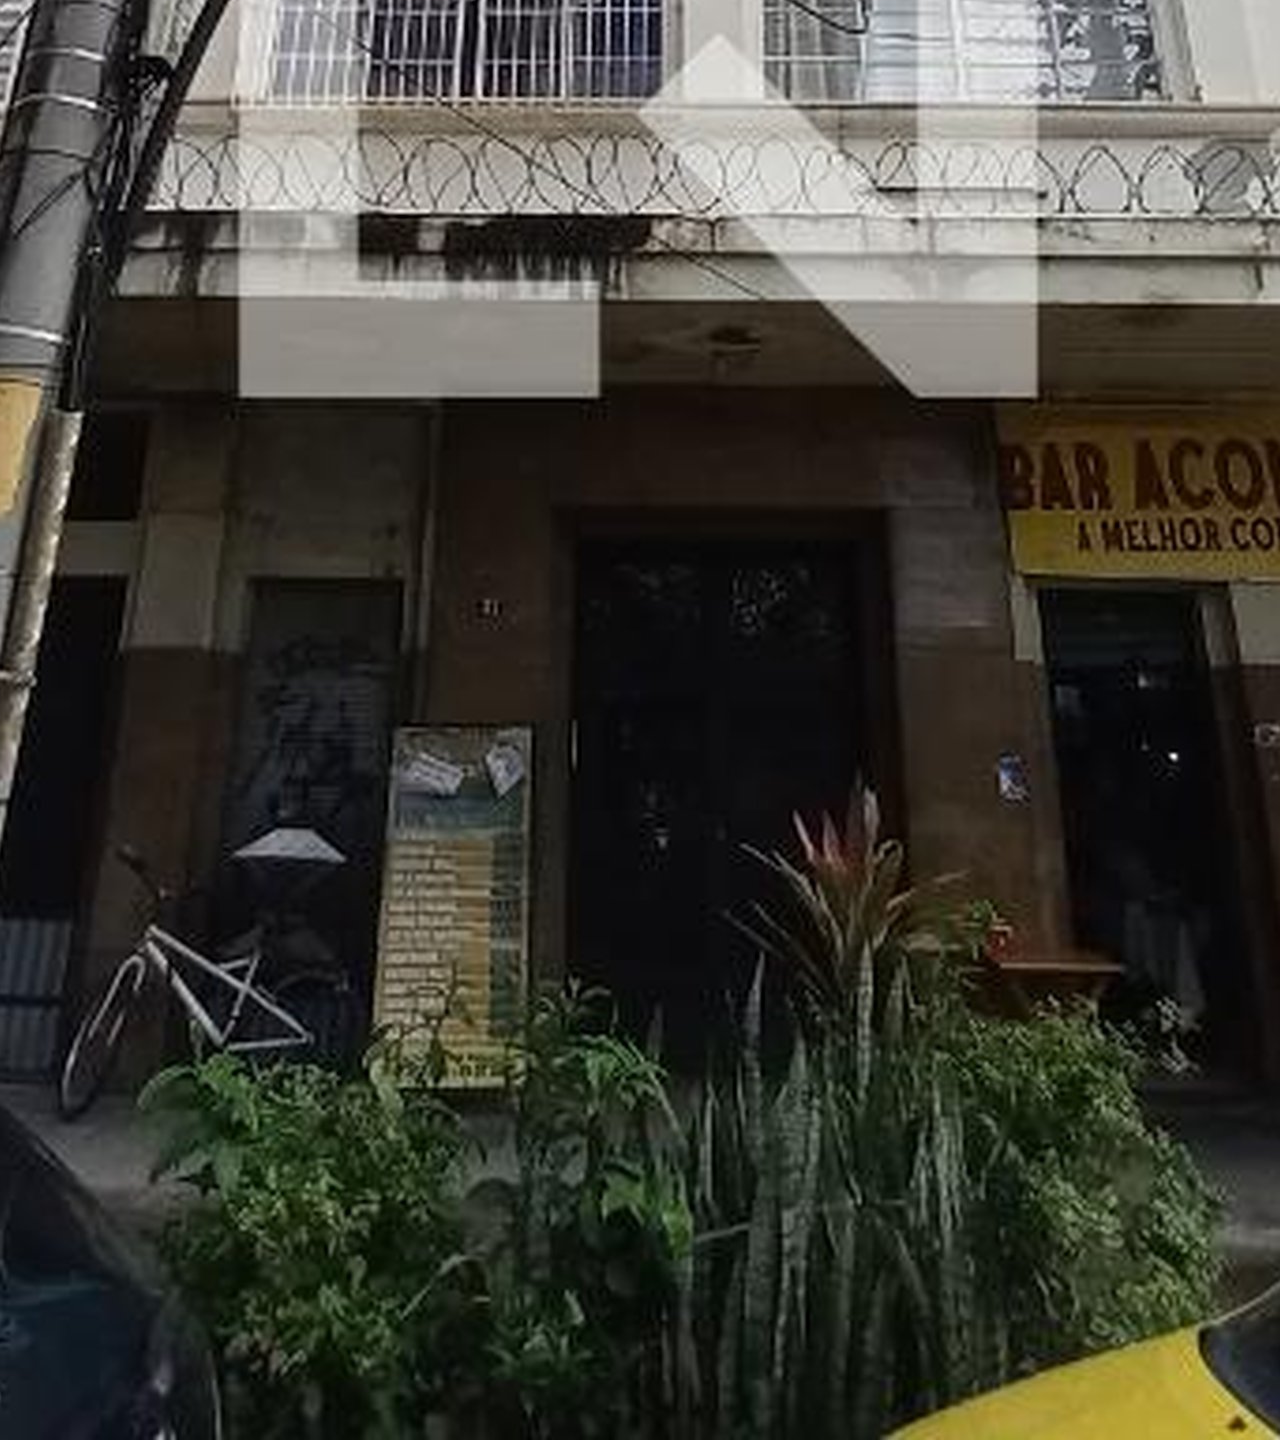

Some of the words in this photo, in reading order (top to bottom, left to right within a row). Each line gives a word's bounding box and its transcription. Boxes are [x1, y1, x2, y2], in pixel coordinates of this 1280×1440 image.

[998, 442, 1113, 510] BAR
[1077, 519, 1091, 553] A
[1100, 518, 1222, 553] MELHOR
